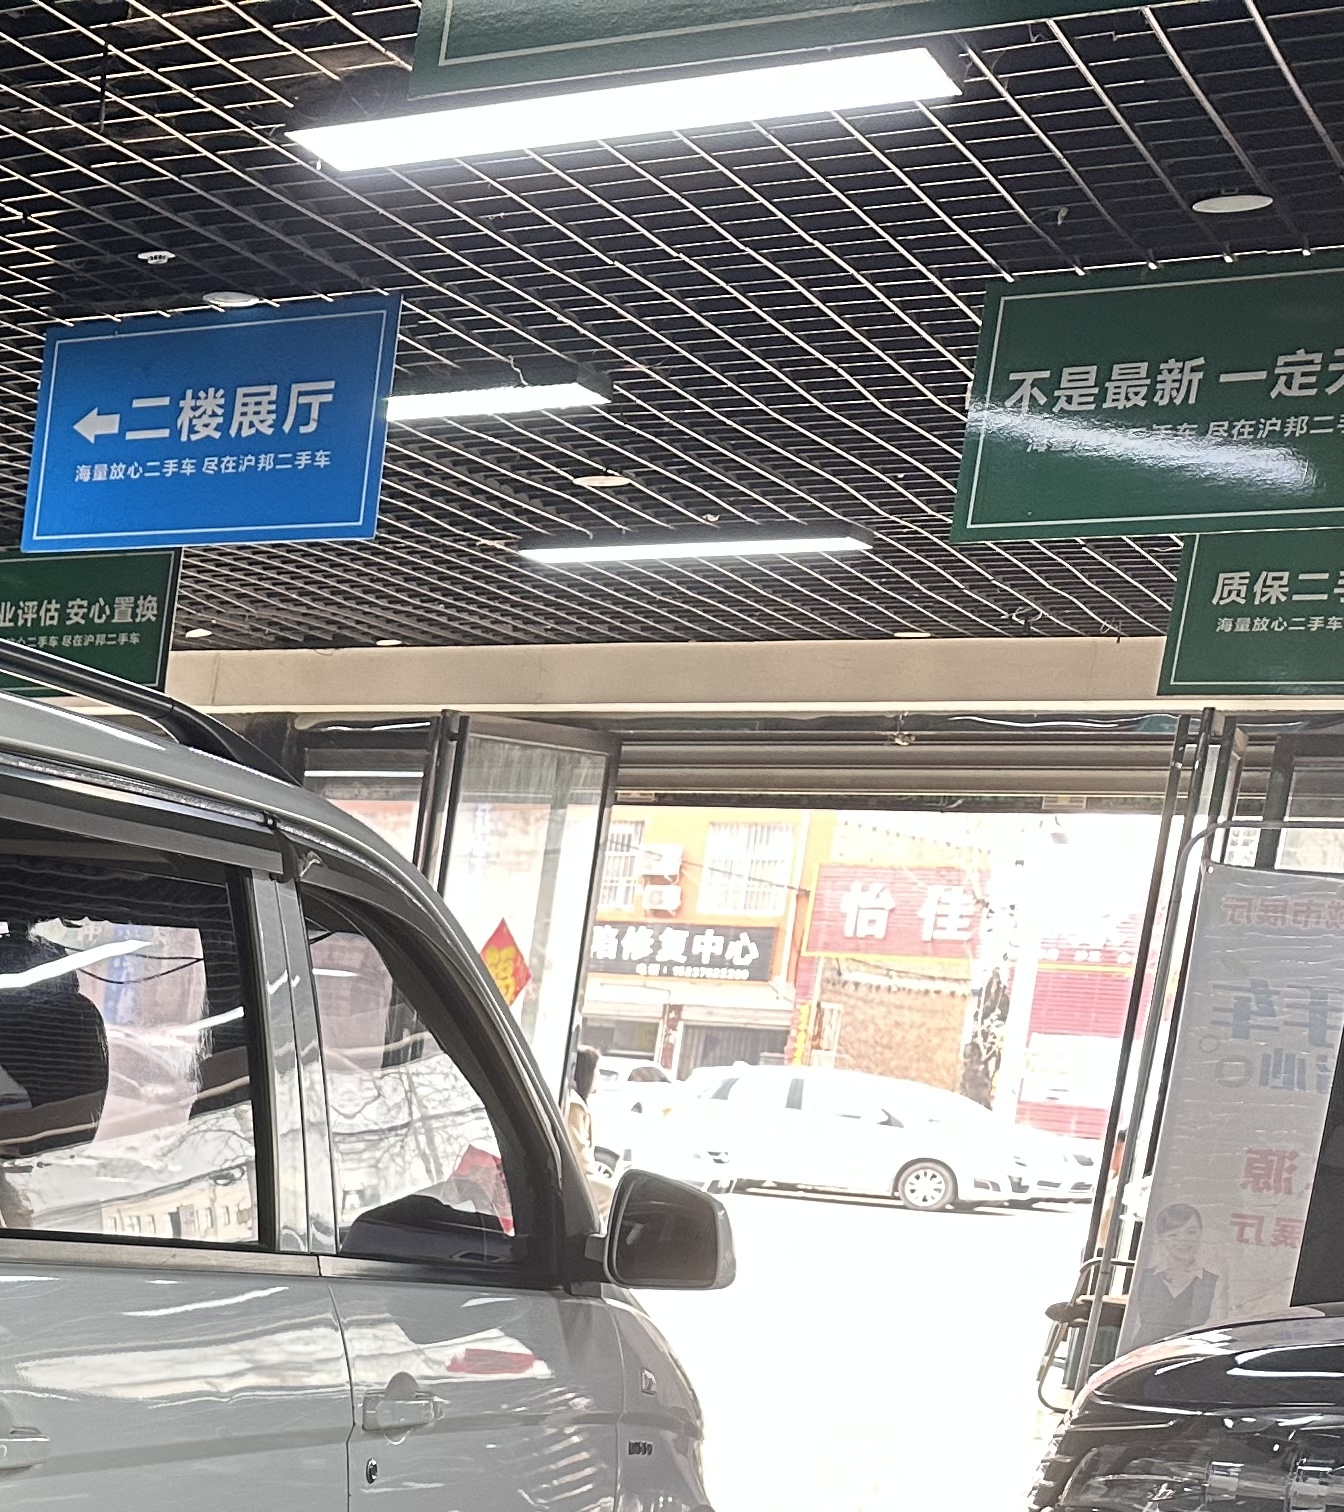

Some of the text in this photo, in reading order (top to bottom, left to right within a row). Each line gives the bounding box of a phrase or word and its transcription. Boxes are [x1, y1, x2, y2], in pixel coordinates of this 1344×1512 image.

[1005, 356, 1205, 413] 不是最新
[125, 380, 336, 442] 二楼展厅
[74, 449, 331, 483] 海量放心二手车 尽在沪邦二手车
[65, 594, 158, 625] 安心置换
[1215, 616, 1344, 632] 海量放心二手车
[62, 632, 141, 647] 尽在沪邦二手车
